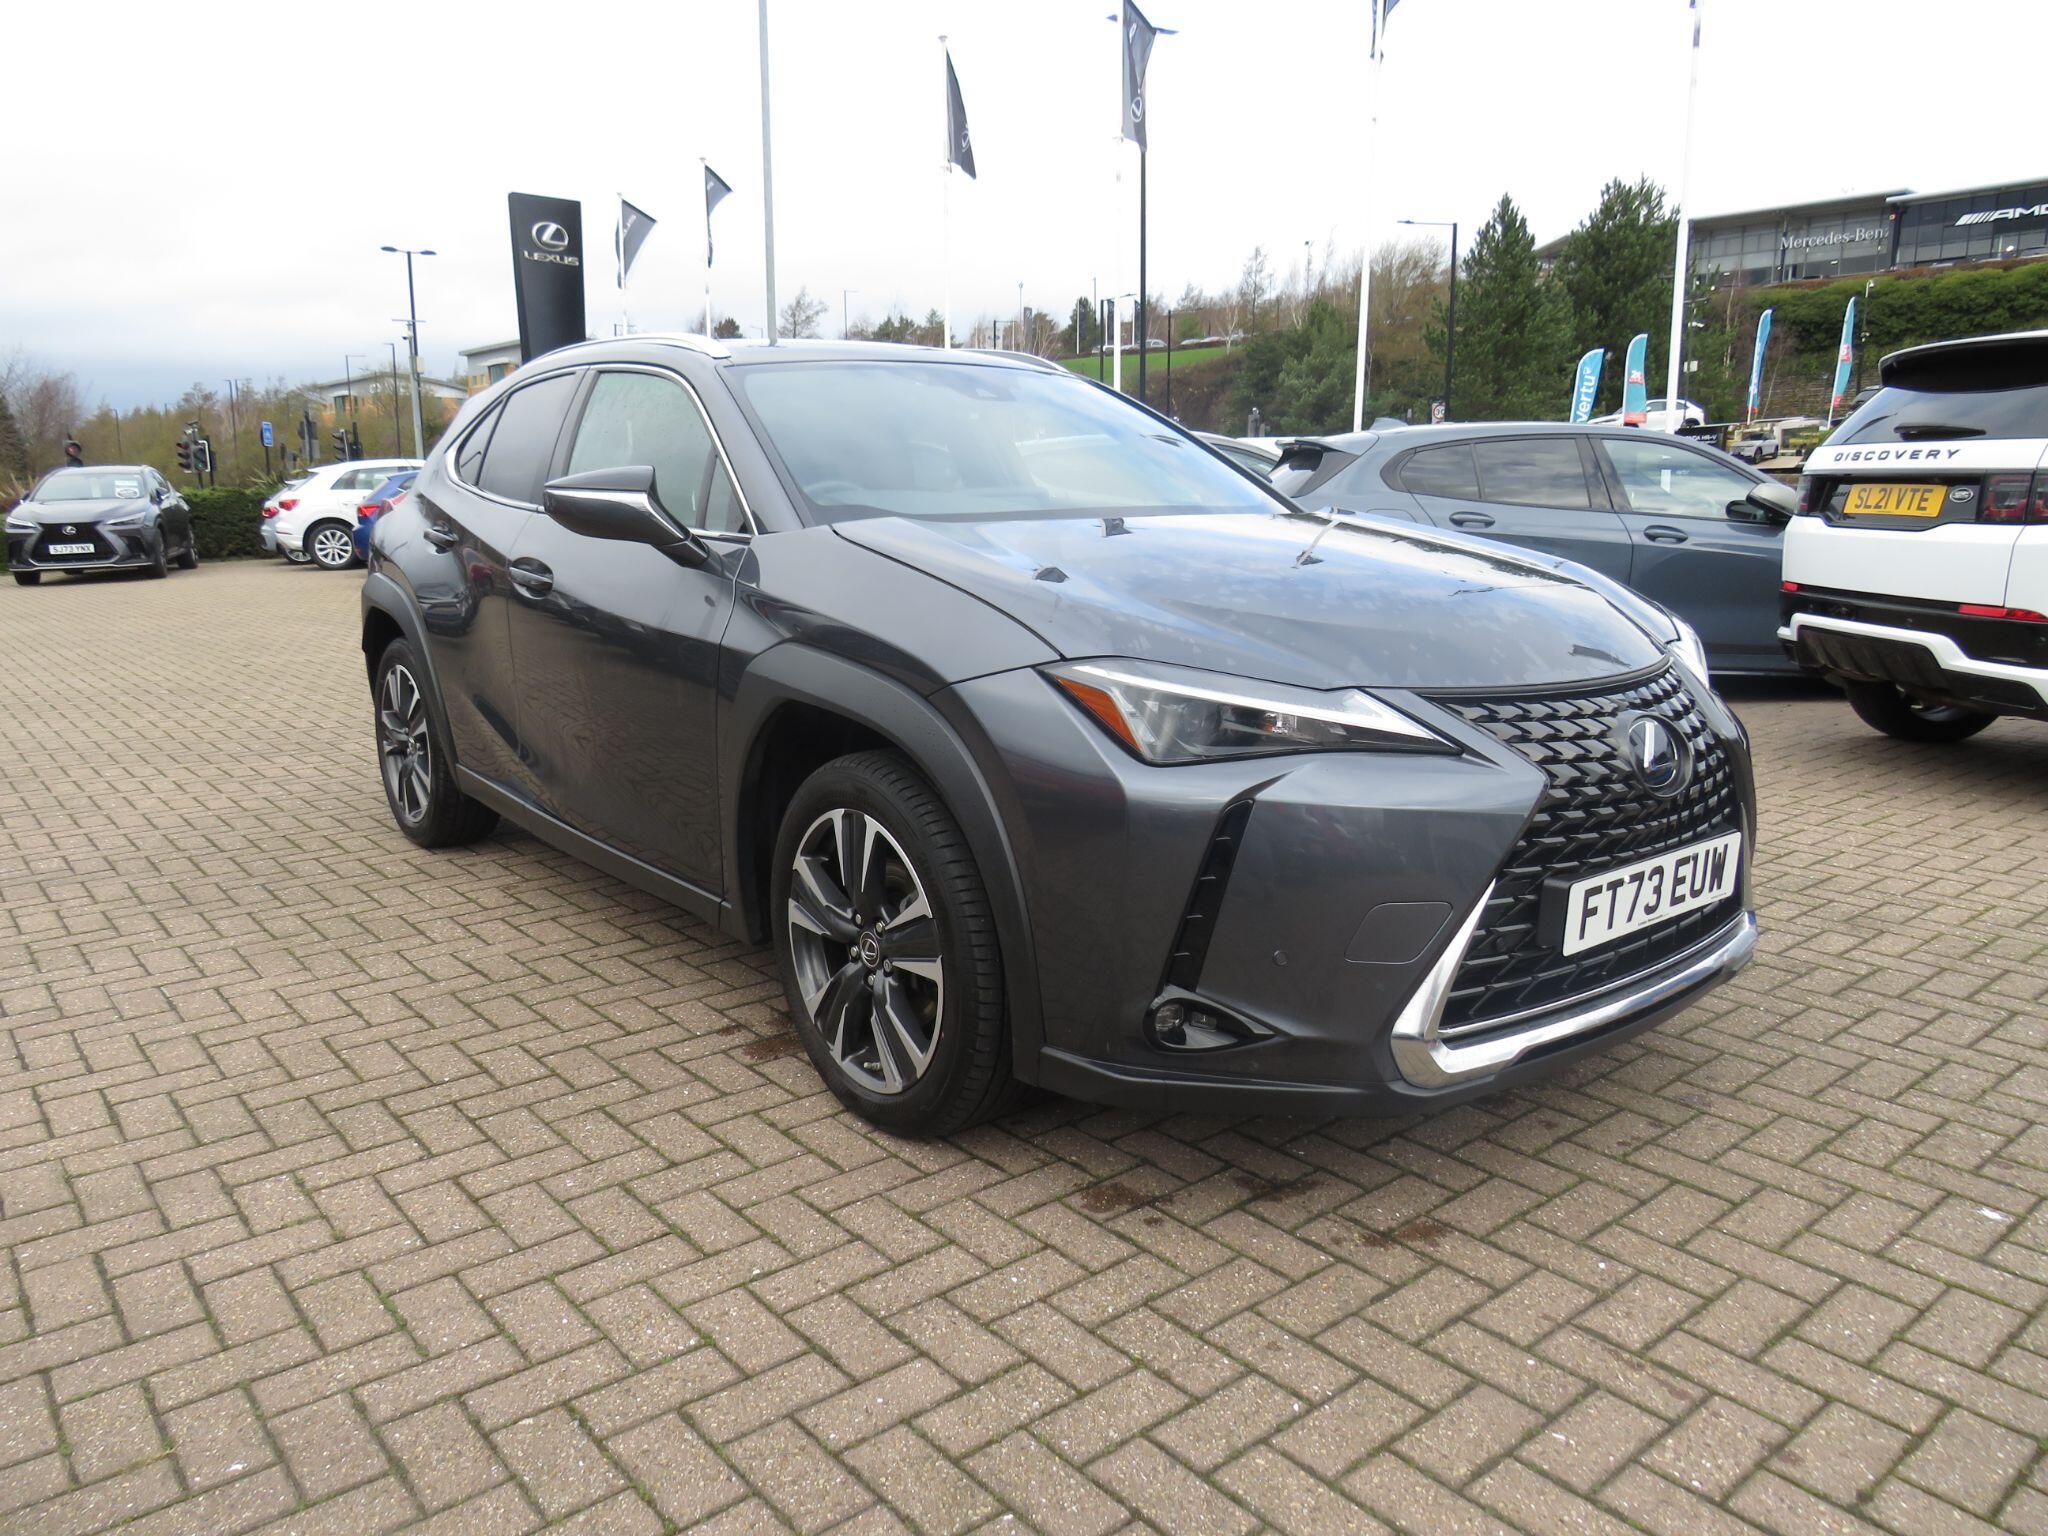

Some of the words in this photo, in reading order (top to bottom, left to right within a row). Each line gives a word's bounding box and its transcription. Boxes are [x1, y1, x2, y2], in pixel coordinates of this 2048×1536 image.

[523, 250, 580, 266] LEXUS
[1834, 448, 1961, 462] DISCOVERY
[1854, 486, 1893, 510] SL21
[1895, 487, 1934, 512] VTE
[1579, 865, 1665, 941] FT73
[1669, 843, 1729, 908] EUW
